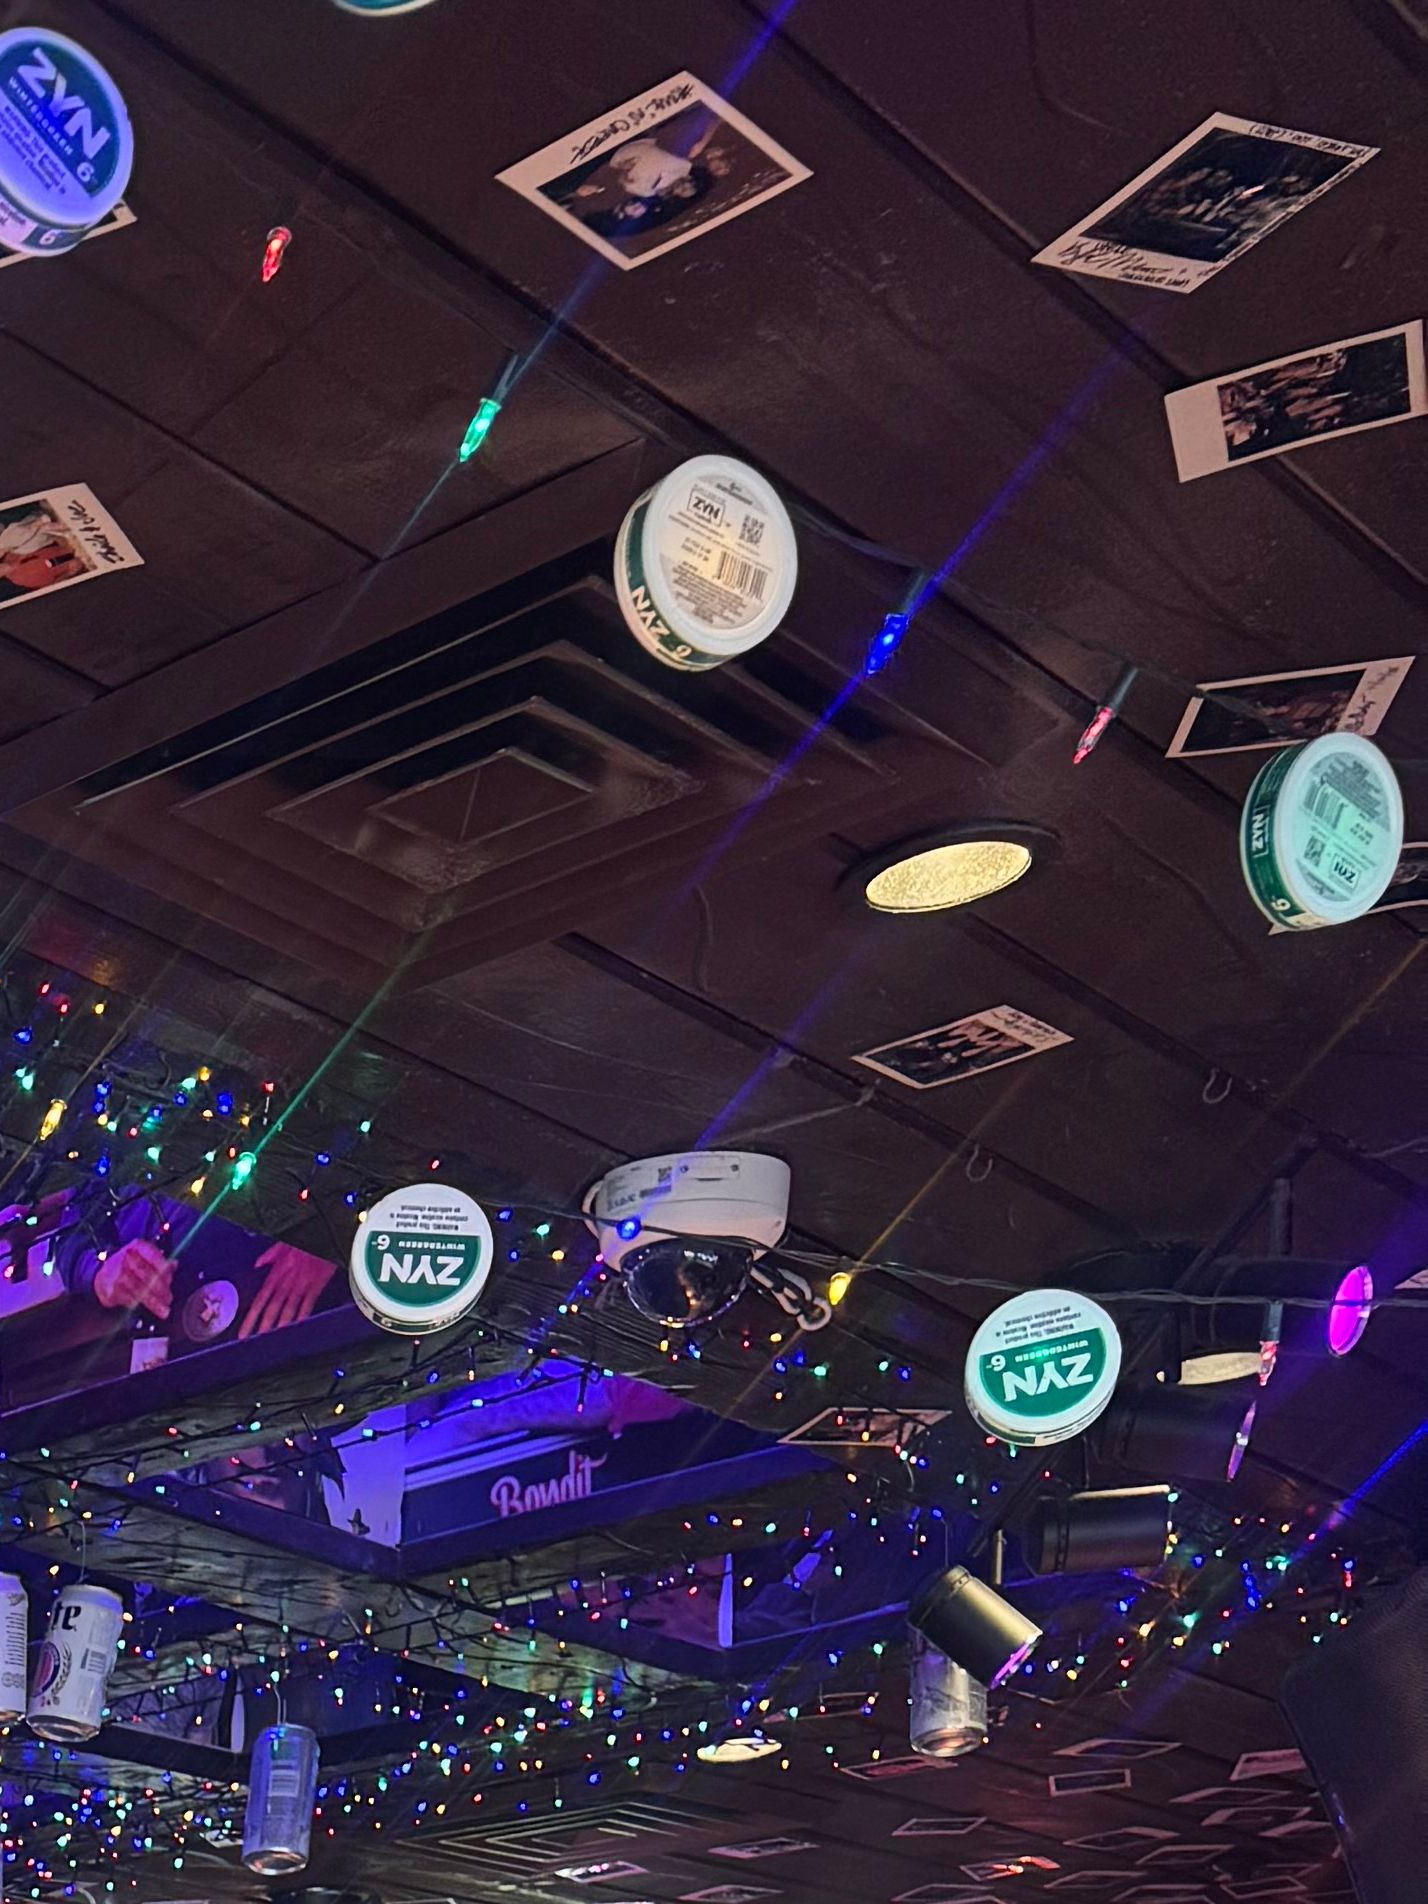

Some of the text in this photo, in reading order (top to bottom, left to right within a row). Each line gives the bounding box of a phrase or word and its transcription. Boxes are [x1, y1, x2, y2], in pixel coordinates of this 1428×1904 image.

[9, 76, 73, 155] WINTERGREEN
[18, 48, 111, 182] ZYN 6
[631, 585, 670, 639] ZYN
[1252, 812, 1266, 852] ZYN
[377, 1235, 465, 1250] WINTERGREEN 6
[379, 1253, 464, 1286] ZYN
[991, 1340, 1088, 1371] WINTERGREEN 6
[1002, 1352, 1093, 1402] ZYN
